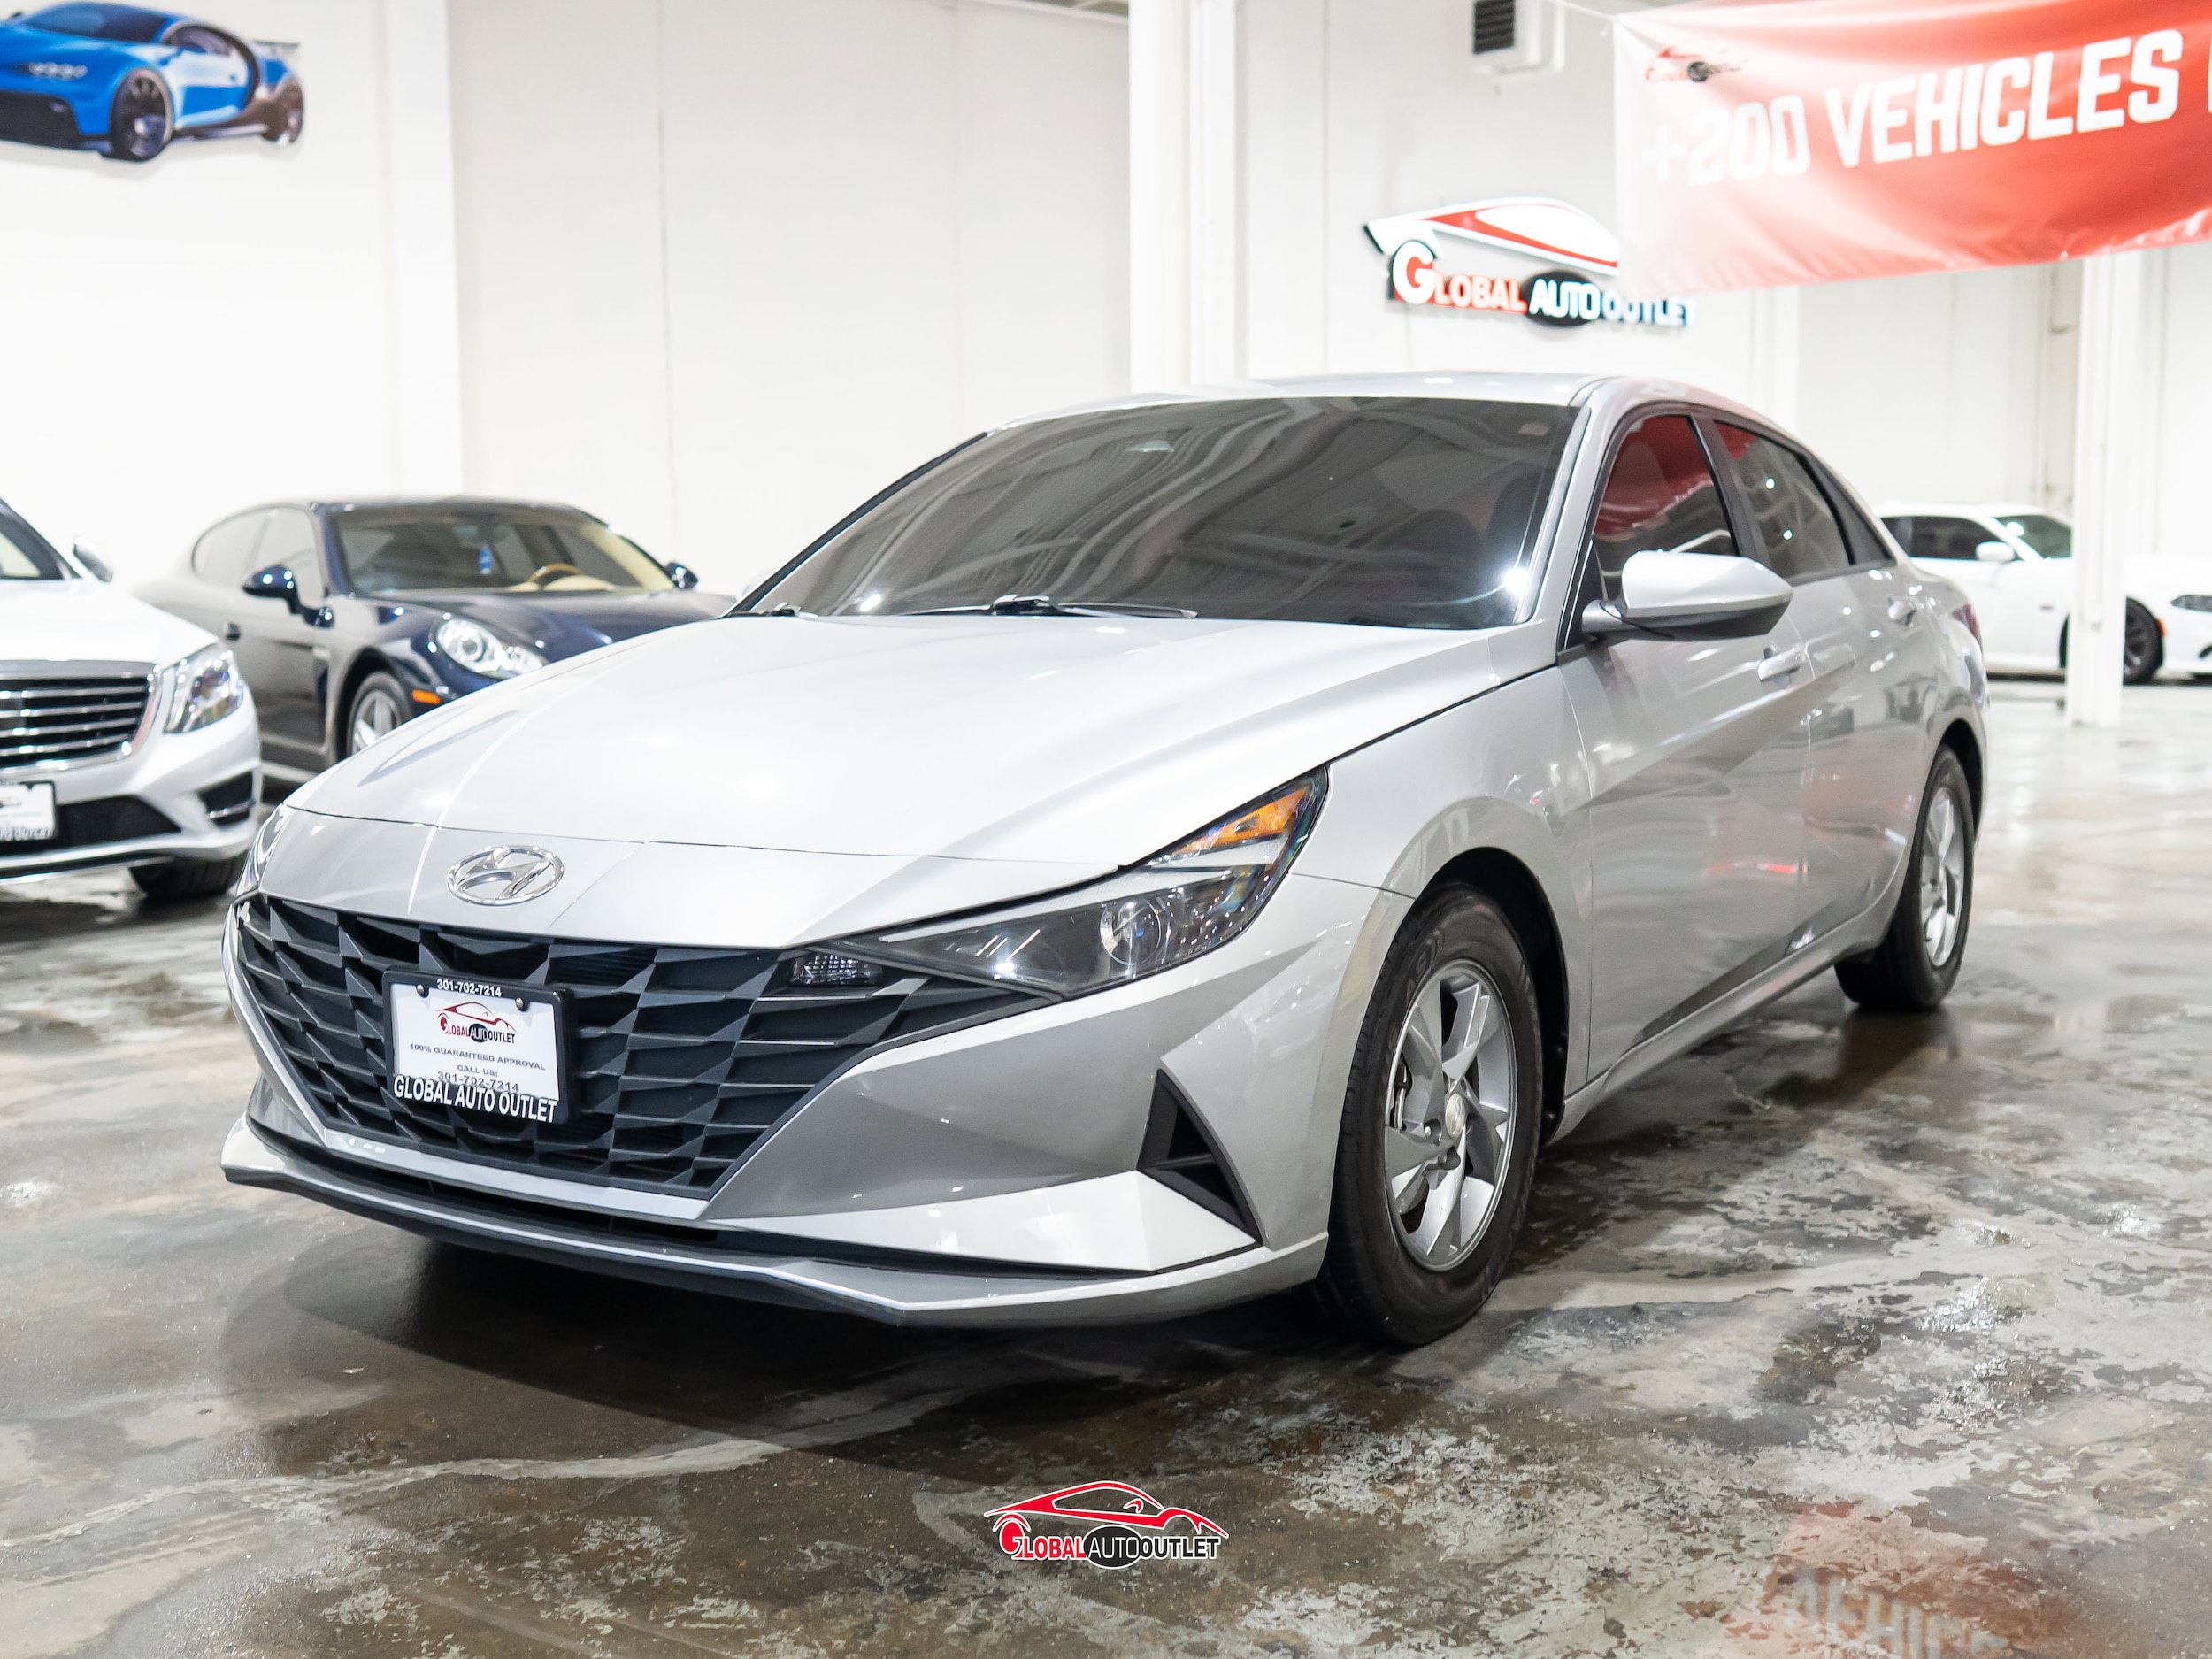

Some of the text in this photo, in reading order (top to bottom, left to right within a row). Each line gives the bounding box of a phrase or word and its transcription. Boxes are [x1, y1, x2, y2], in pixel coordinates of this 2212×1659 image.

[1643, 94, 1811, 187] +200
[1824, 28, 2184, 168] VEHICLES
[1391, 240, 1528, 314] GLOBAL
[1528, 278, 1601, 321] AUTO
[436, 979, 502, 997] 301-702-7214
[440, 1016, 515, 1044] GLOBAL AUTO OUTLET
[410, 1043, 546, 1071] 100% GUARANTEED APPROVAL
[457, 1064, 480, 1074] CALL
[437, 1071, 519, 1092] 301-702-7214
[393, 1074, 557, 1123] GLOBAL AUTO OUTLET
